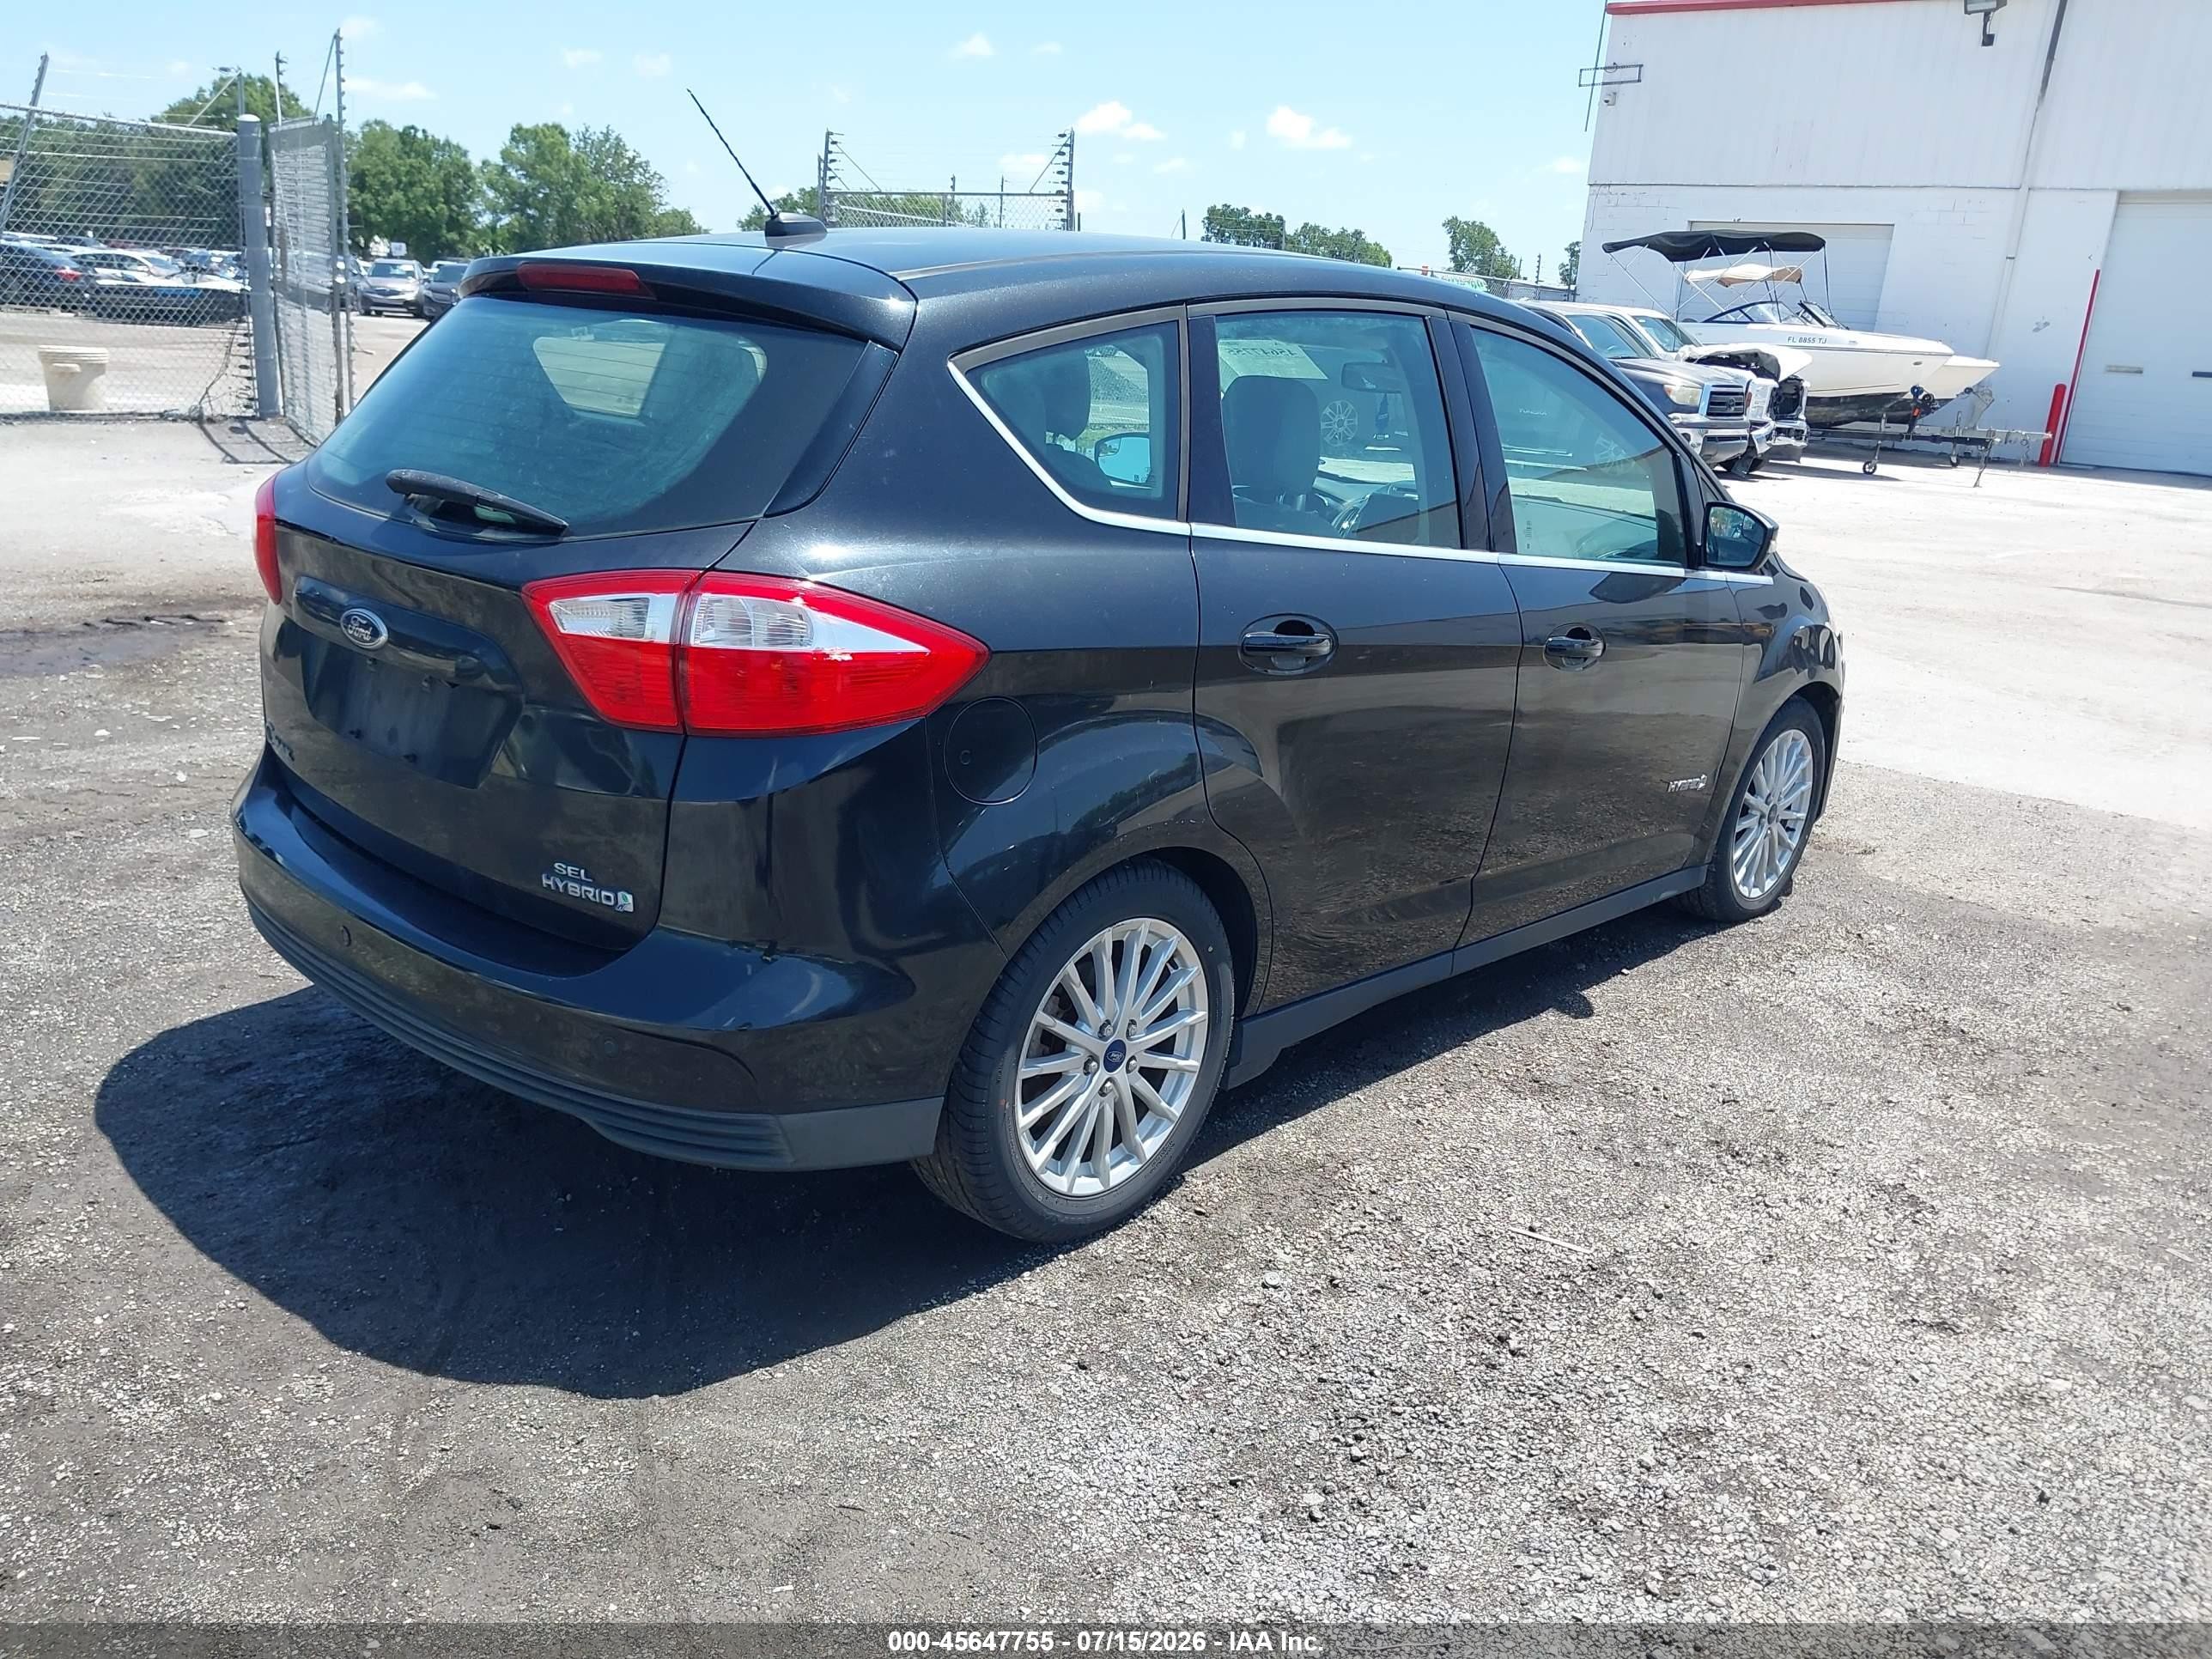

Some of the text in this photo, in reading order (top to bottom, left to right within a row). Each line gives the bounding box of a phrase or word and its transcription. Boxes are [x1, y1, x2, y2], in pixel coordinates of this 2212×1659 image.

[347, 615, 373, 641] Ford
[553, 861, 593, 883] SEL
[542, 873, 616, 906] HYBRID
